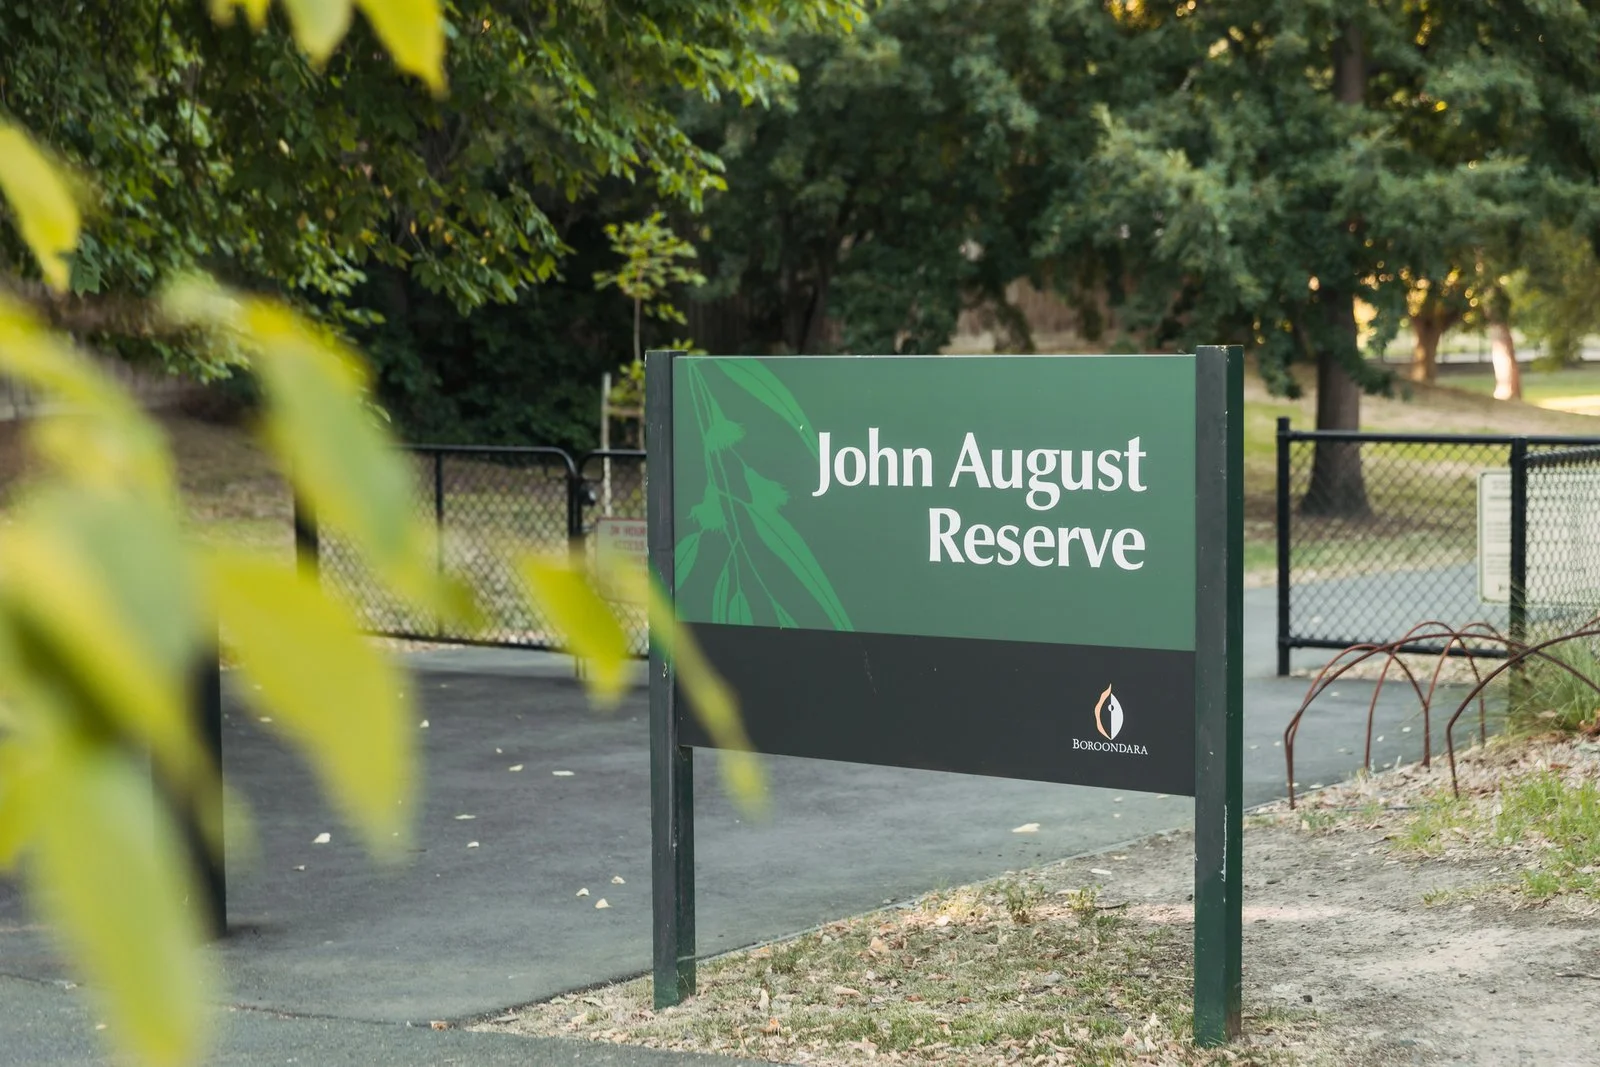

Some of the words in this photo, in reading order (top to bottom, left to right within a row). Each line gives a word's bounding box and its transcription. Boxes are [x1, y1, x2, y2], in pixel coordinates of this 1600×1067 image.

[812, 427, 933, 497] John
[949, 432, 1147, 511] August
[929, 507, 1146, 570] Reserve
[1072, 738, 1149, 755] BOROONDARA
